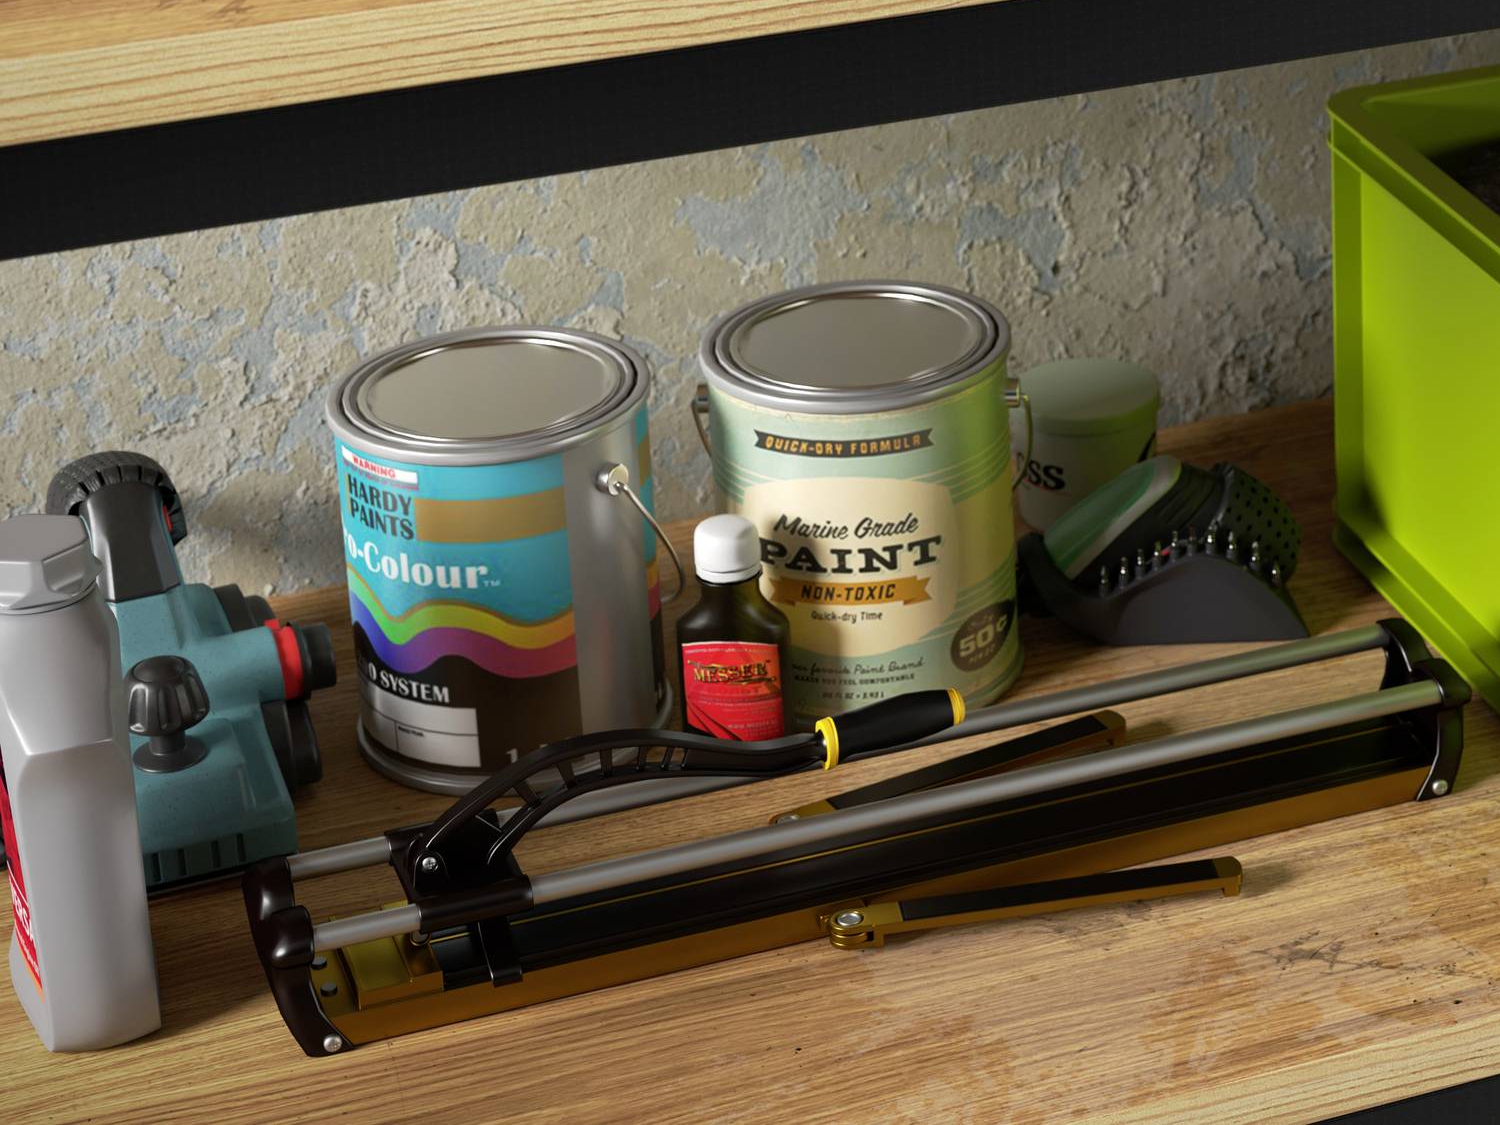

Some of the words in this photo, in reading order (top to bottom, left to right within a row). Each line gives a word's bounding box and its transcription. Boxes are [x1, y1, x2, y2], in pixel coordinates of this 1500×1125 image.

[764, 435, 843, 456] QUICK-DRY
[850, 434, 922, 455] FORMULA
[352, 455, 397, 479] WARNING
[346, 474, 413, 516] HARDY
[349, 496, 416, 541] PAINTS
[773, 513, 849, 540] Marine
[854, 512, 920, 539] Grade
[759, 535, 943, 574] PAINT
[800, 584, 896, 602] NON-TOXIC
[811, 611, 857, 624] Quick-dry
[860, 611, 883, 621] Time
[888, 656, 926, 672] Brand
[379, 668, 450, 704] SYSTEM
